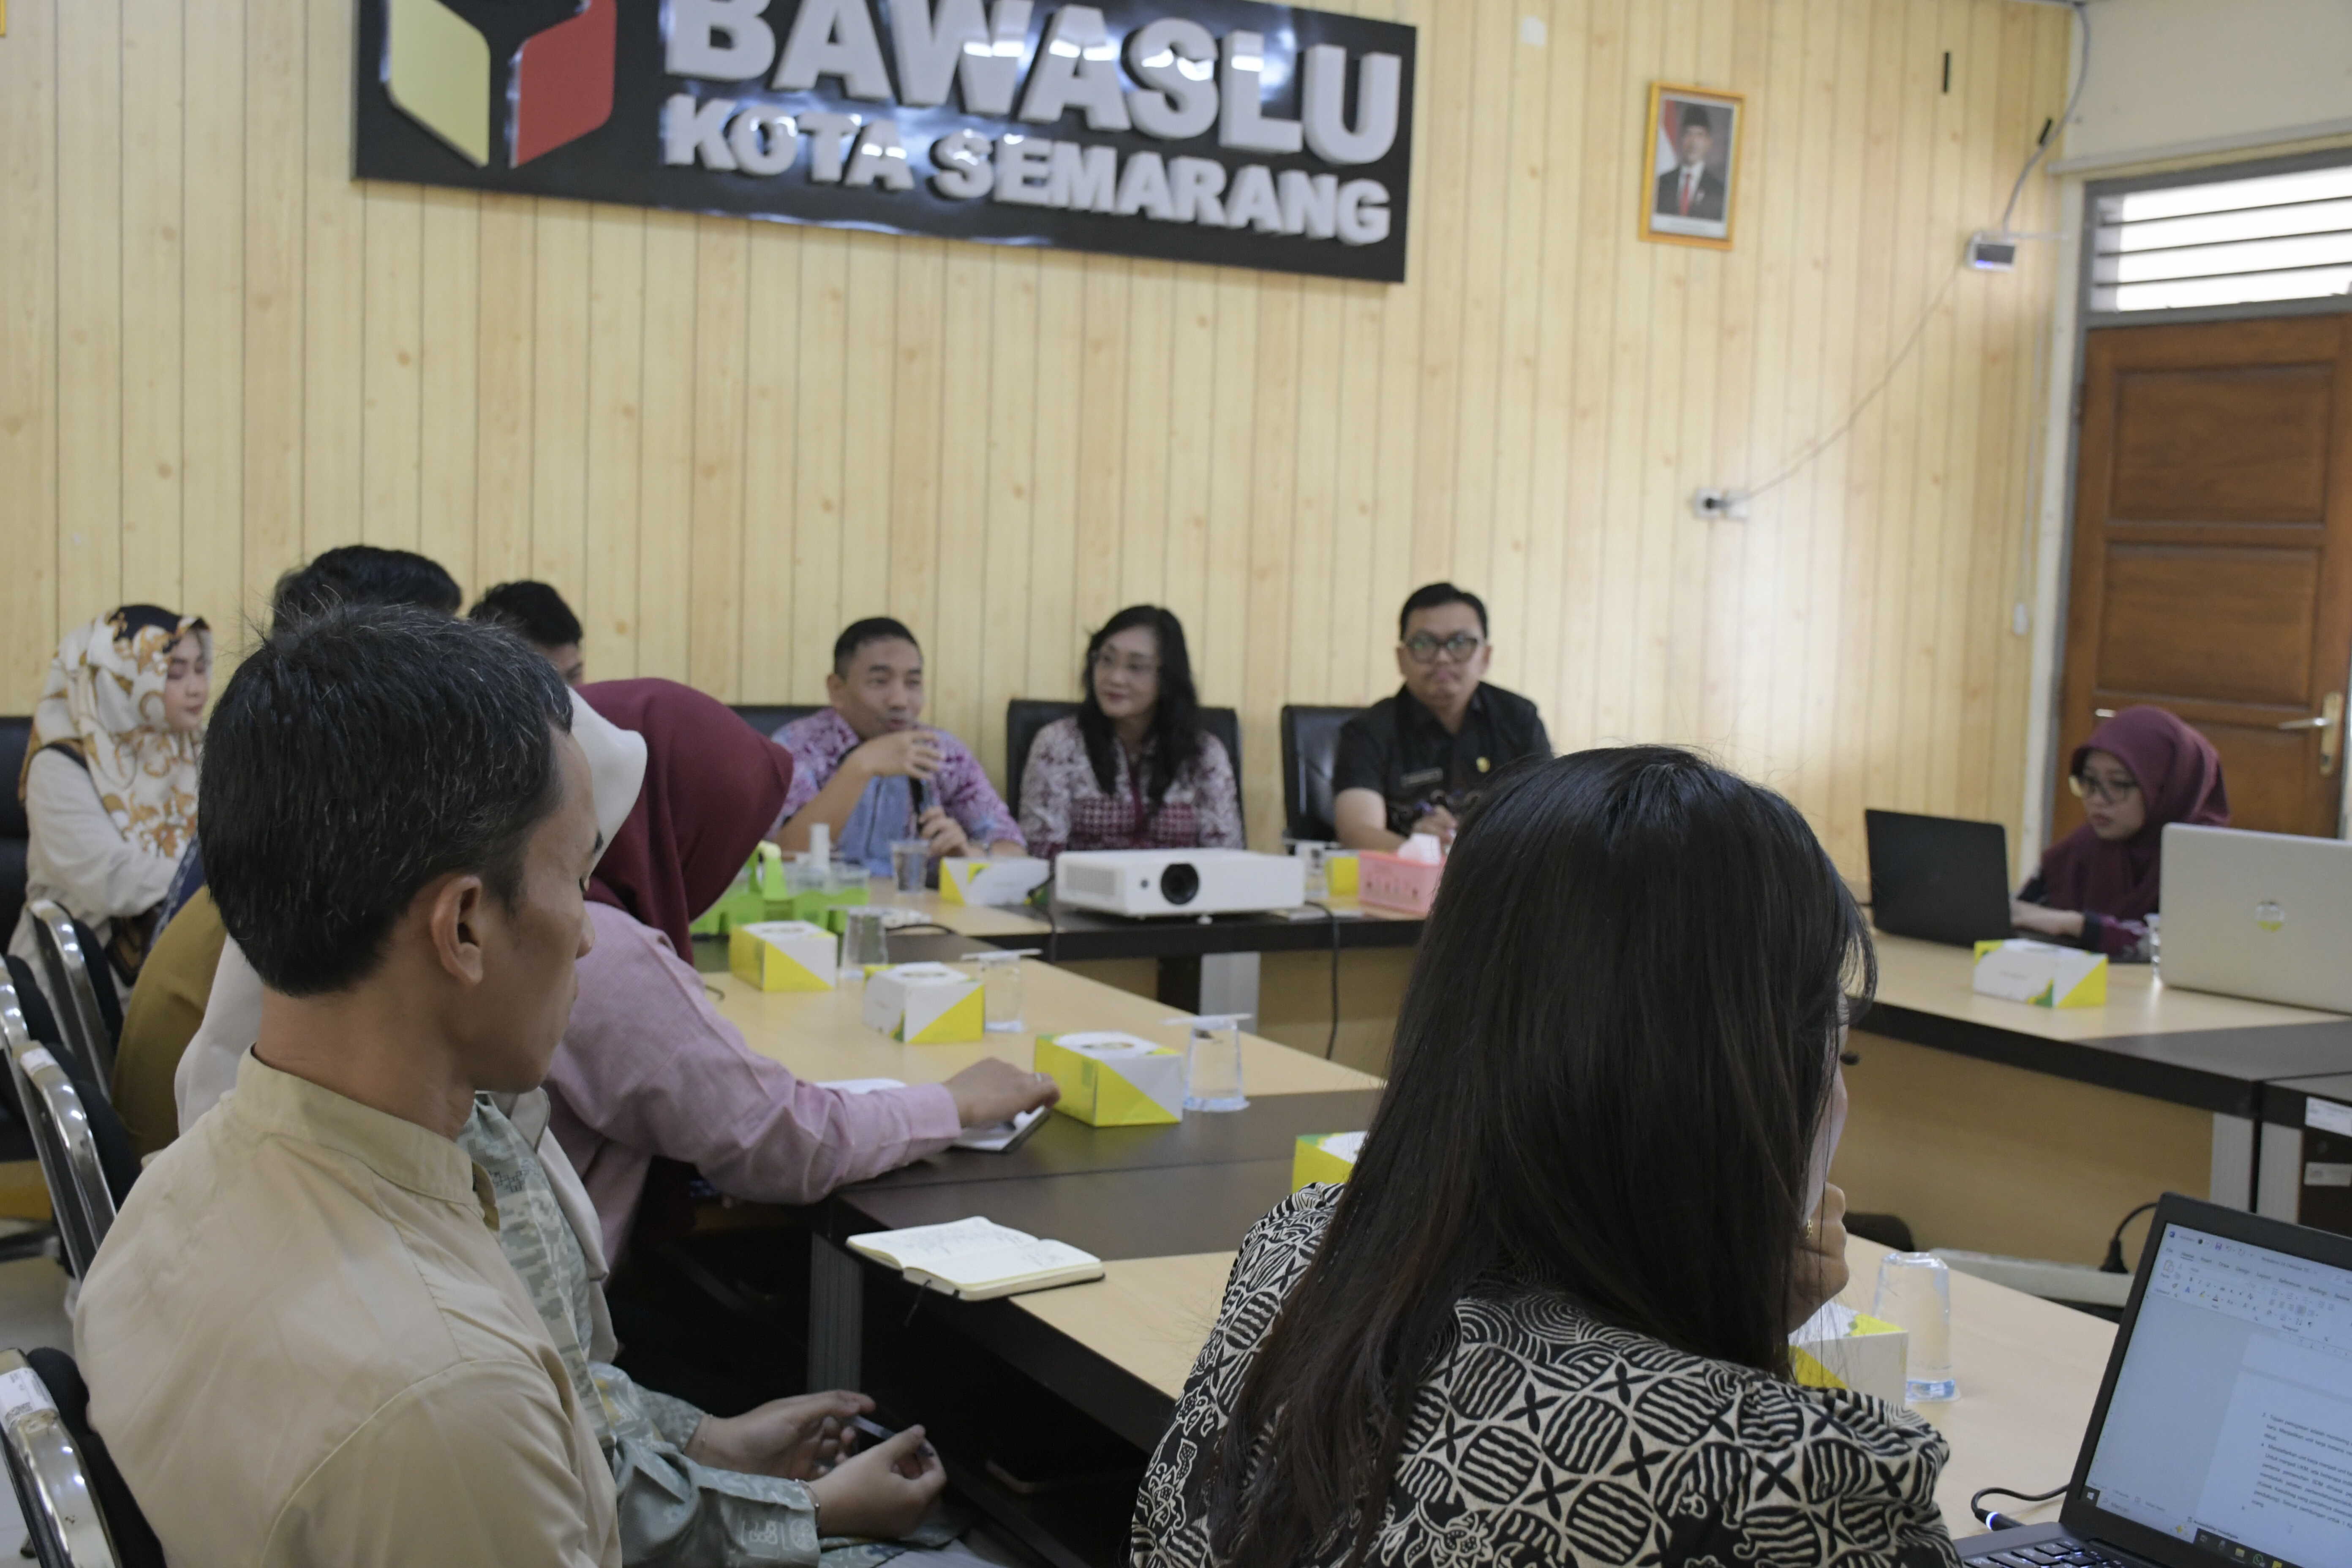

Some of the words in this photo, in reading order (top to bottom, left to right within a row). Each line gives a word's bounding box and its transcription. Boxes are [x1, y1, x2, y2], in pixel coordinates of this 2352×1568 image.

[665, 0, 1401, 164] BAWASLU
[665, 94, 916, 191] KOTA
[933, 129, 1391, 246] SEMARANG
